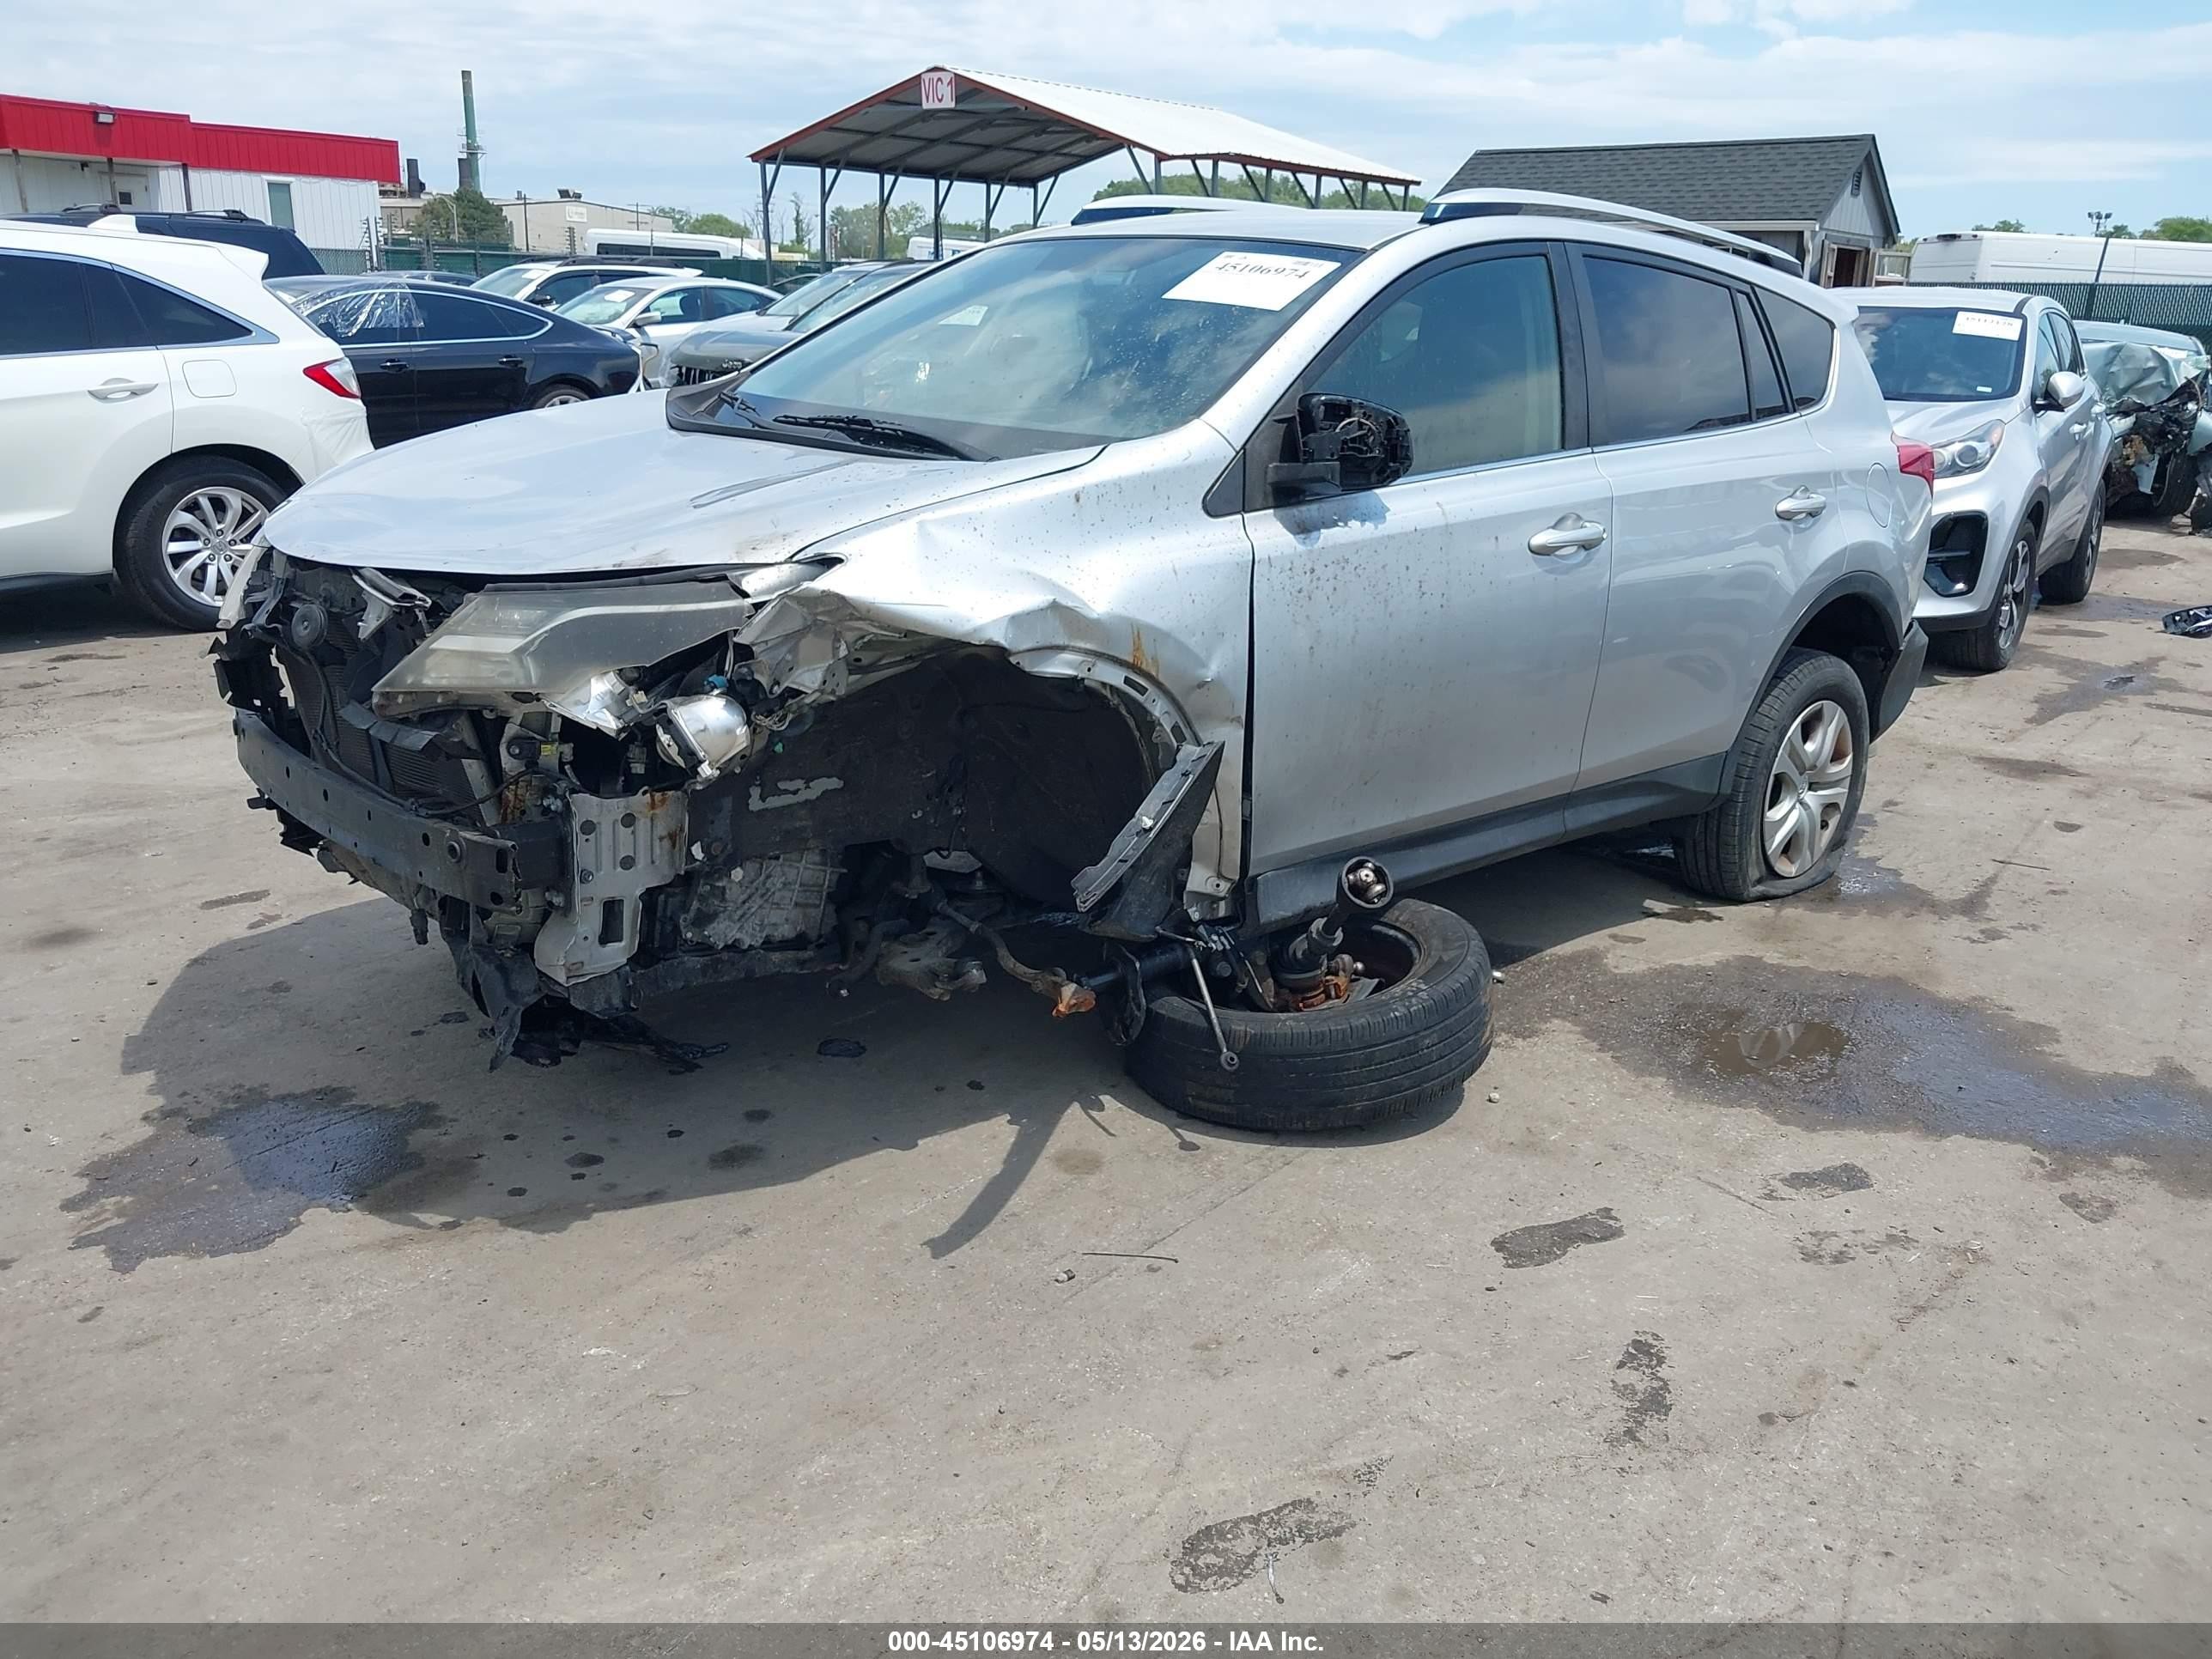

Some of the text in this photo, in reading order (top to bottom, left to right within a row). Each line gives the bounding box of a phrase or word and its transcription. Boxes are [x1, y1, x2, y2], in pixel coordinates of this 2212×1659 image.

[922, 76, 954, 103] VIC 1
[1215, 262, 1311, 279] 45106974
